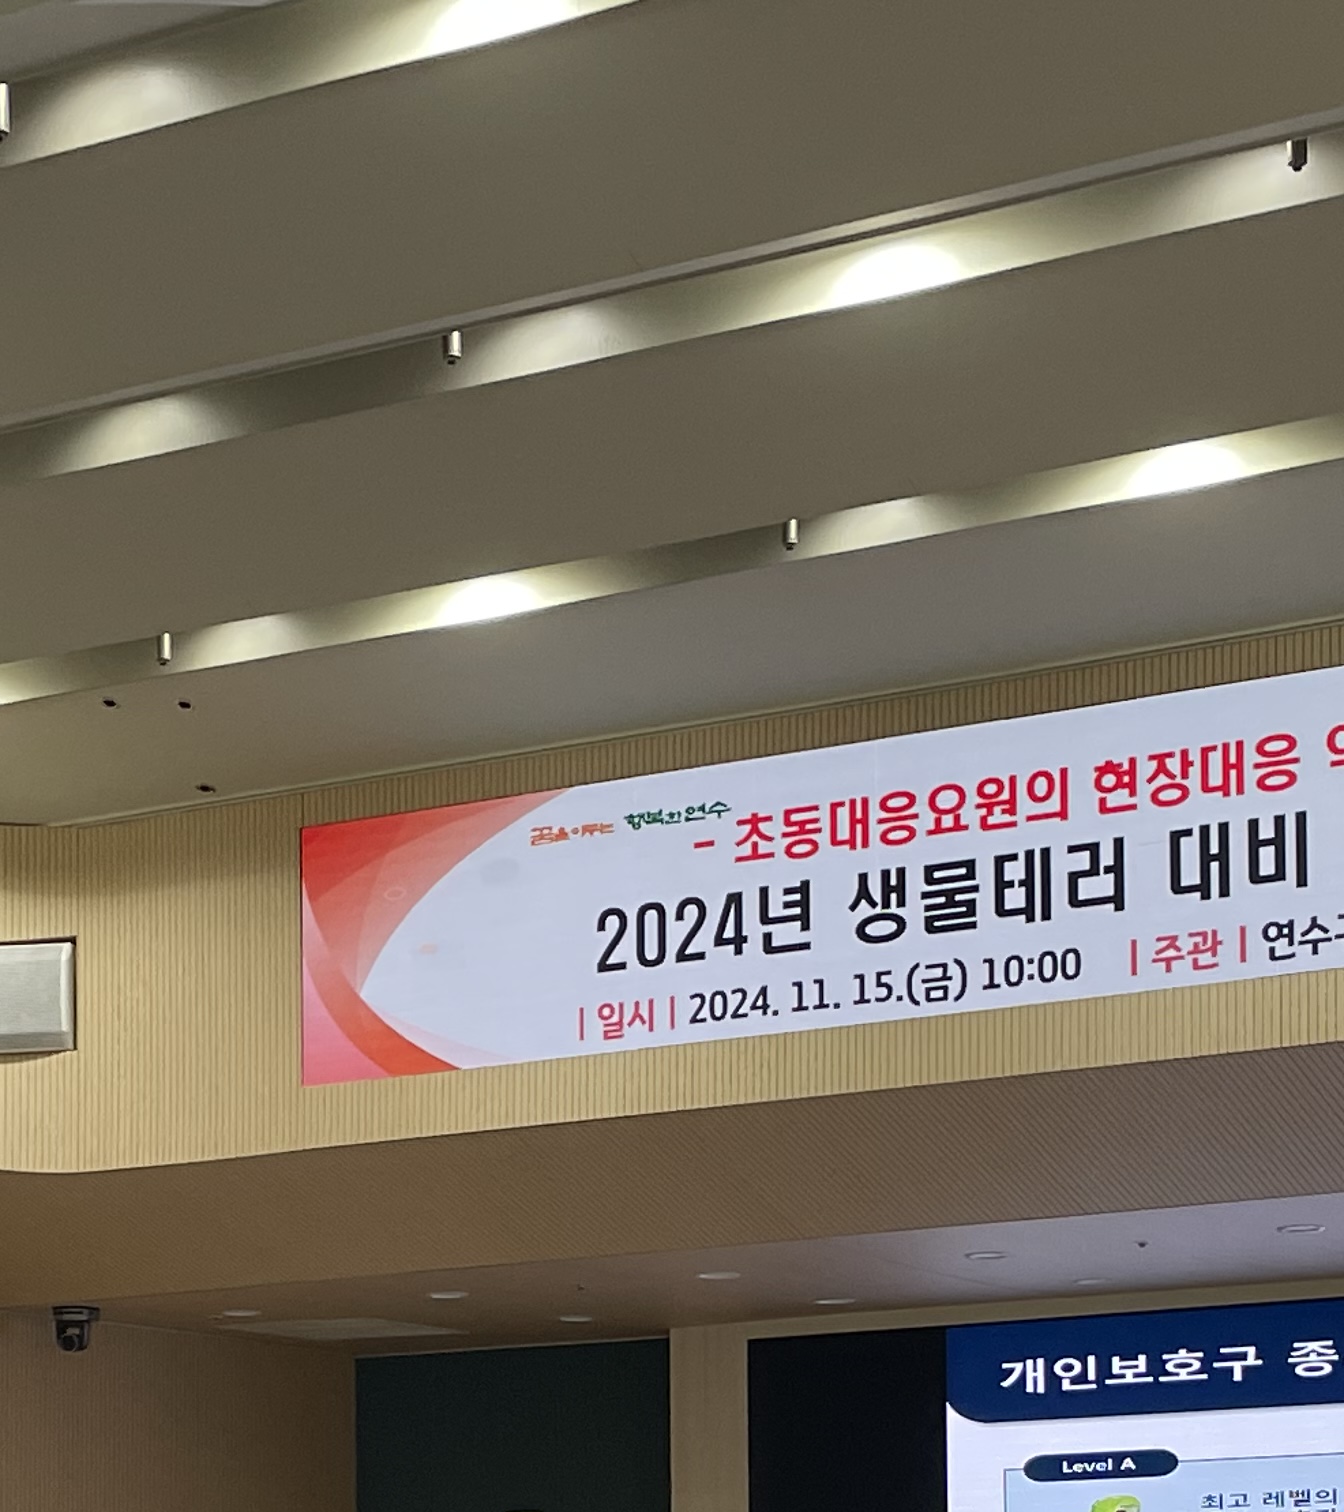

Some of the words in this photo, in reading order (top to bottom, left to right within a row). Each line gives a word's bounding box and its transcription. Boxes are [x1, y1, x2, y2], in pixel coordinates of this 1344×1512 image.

[684, 801, 733, 823] 연수
[733, 767, 1070, 864] 초동대응요원의
[1093, 732, 1301, 815] 현장대응
[596, 878, 813, 974] 2024년
[848, 836, 1126, 945] 생물테러
[1169, 809, 1309, 901] 대비
[596, 998, 657, 1040] 일시
[688, 989, 780, 1025] 2024.
[790, 979, 841, 1014] 11.
[852, 959, 968, 1010] 15.(금)
[982, 947, 1083, 991] 10:00
[1151, 927, 1224, 976] 주관
[999, 1343, 1264, 1395] 개인보호구
[1062, 1457, 1113, 1474] Level
[1119, 1456, 1137, 1471] A
[1201, 1492, 1252, 1510] 최고
[1261, 1487, 1339, 1508] 레벨의
